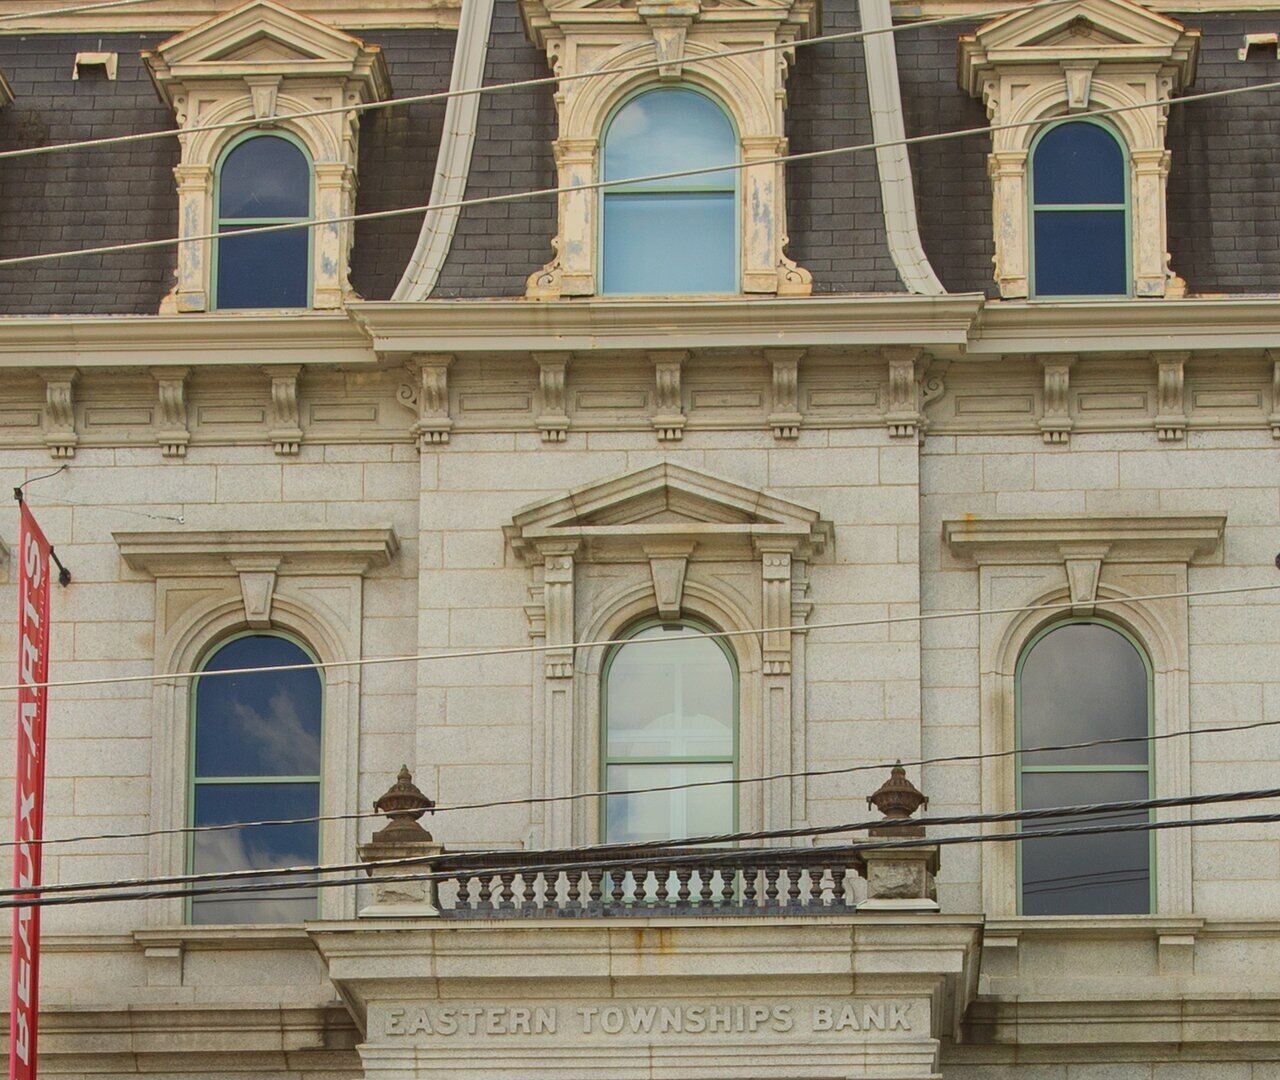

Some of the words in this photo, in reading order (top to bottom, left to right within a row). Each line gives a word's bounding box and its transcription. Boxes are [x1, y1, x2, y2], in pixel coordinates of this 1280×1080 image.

[383, 1006, 558, 1036] EASTERN
[577, 1004, 795, 1034] TOWNSHIPS
[812, 1001, 914, 1033] BANK
